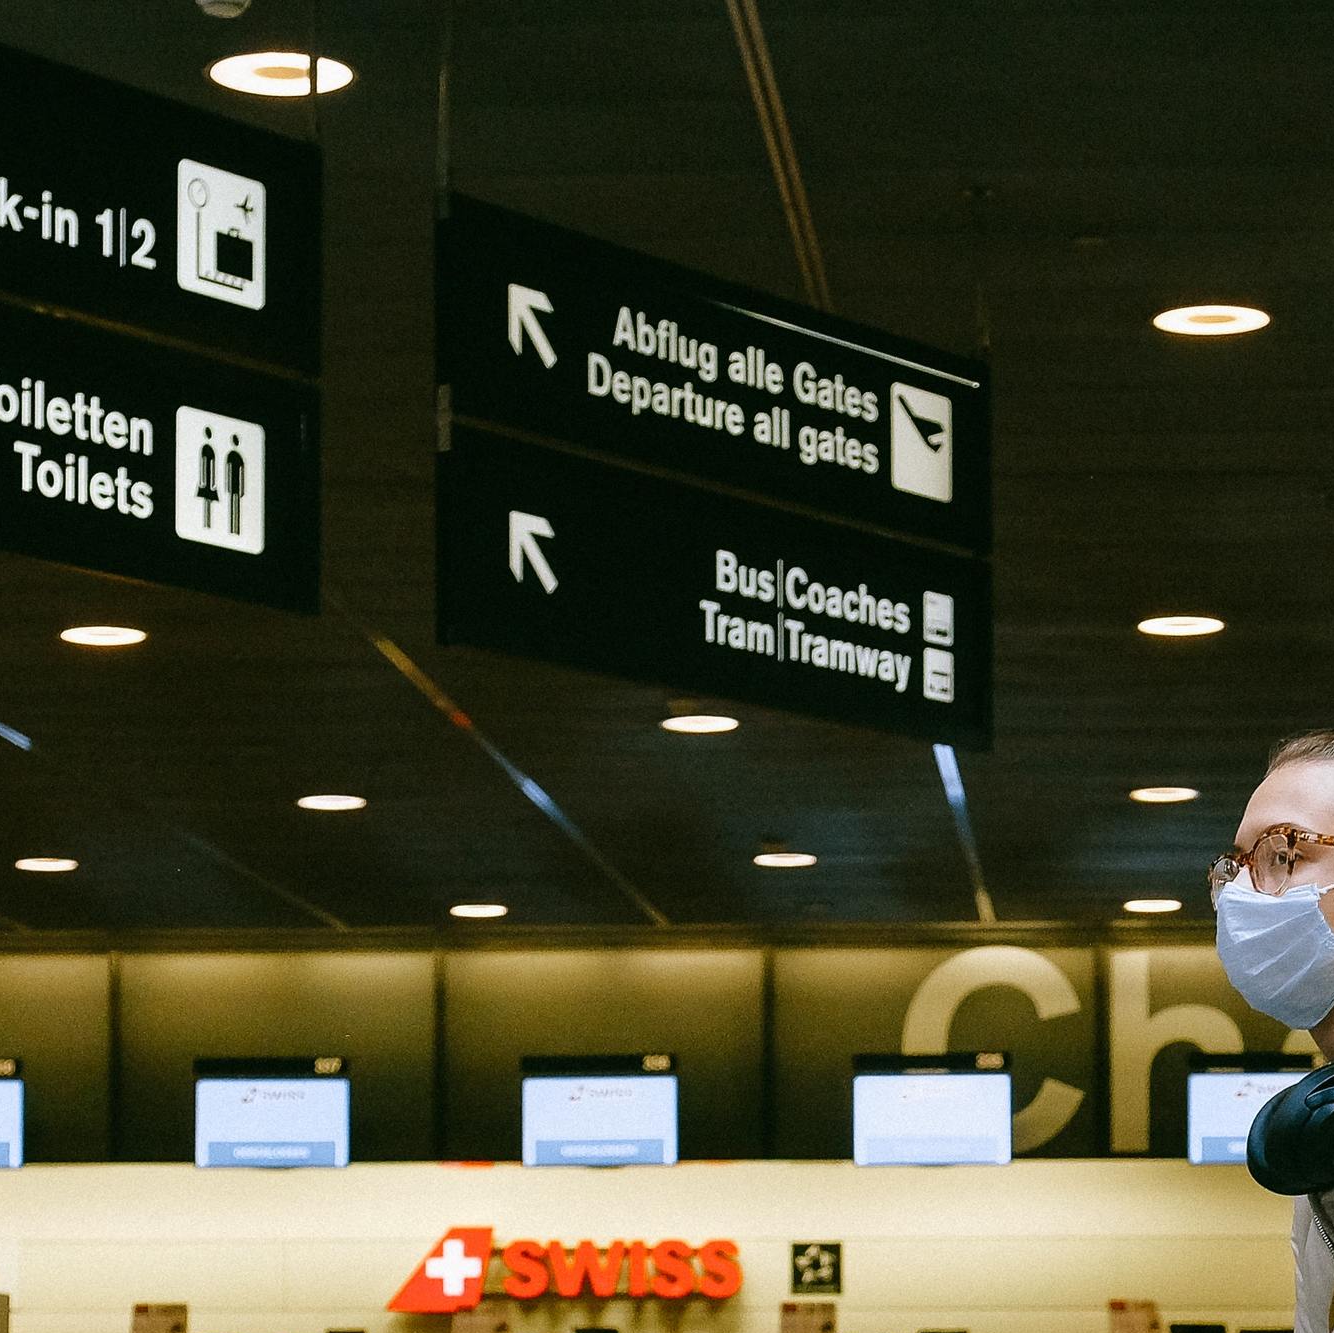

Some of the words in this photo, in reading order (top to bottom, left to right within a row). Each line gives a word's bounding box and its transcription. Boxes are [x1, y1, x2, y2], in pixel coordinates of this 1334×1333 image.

[587, 351, 745, 436] Departure
[753, 405, 791, 450] all
[798, 425, 880, 474] gates
[612, 306, 718, 383] Abflug
[727, 345, 785, 395] alle
[793, 361, 880, 423] Gates
[13, 440, 154, 519] Toilets
[501, 1239, 744, 1299] SWISS
